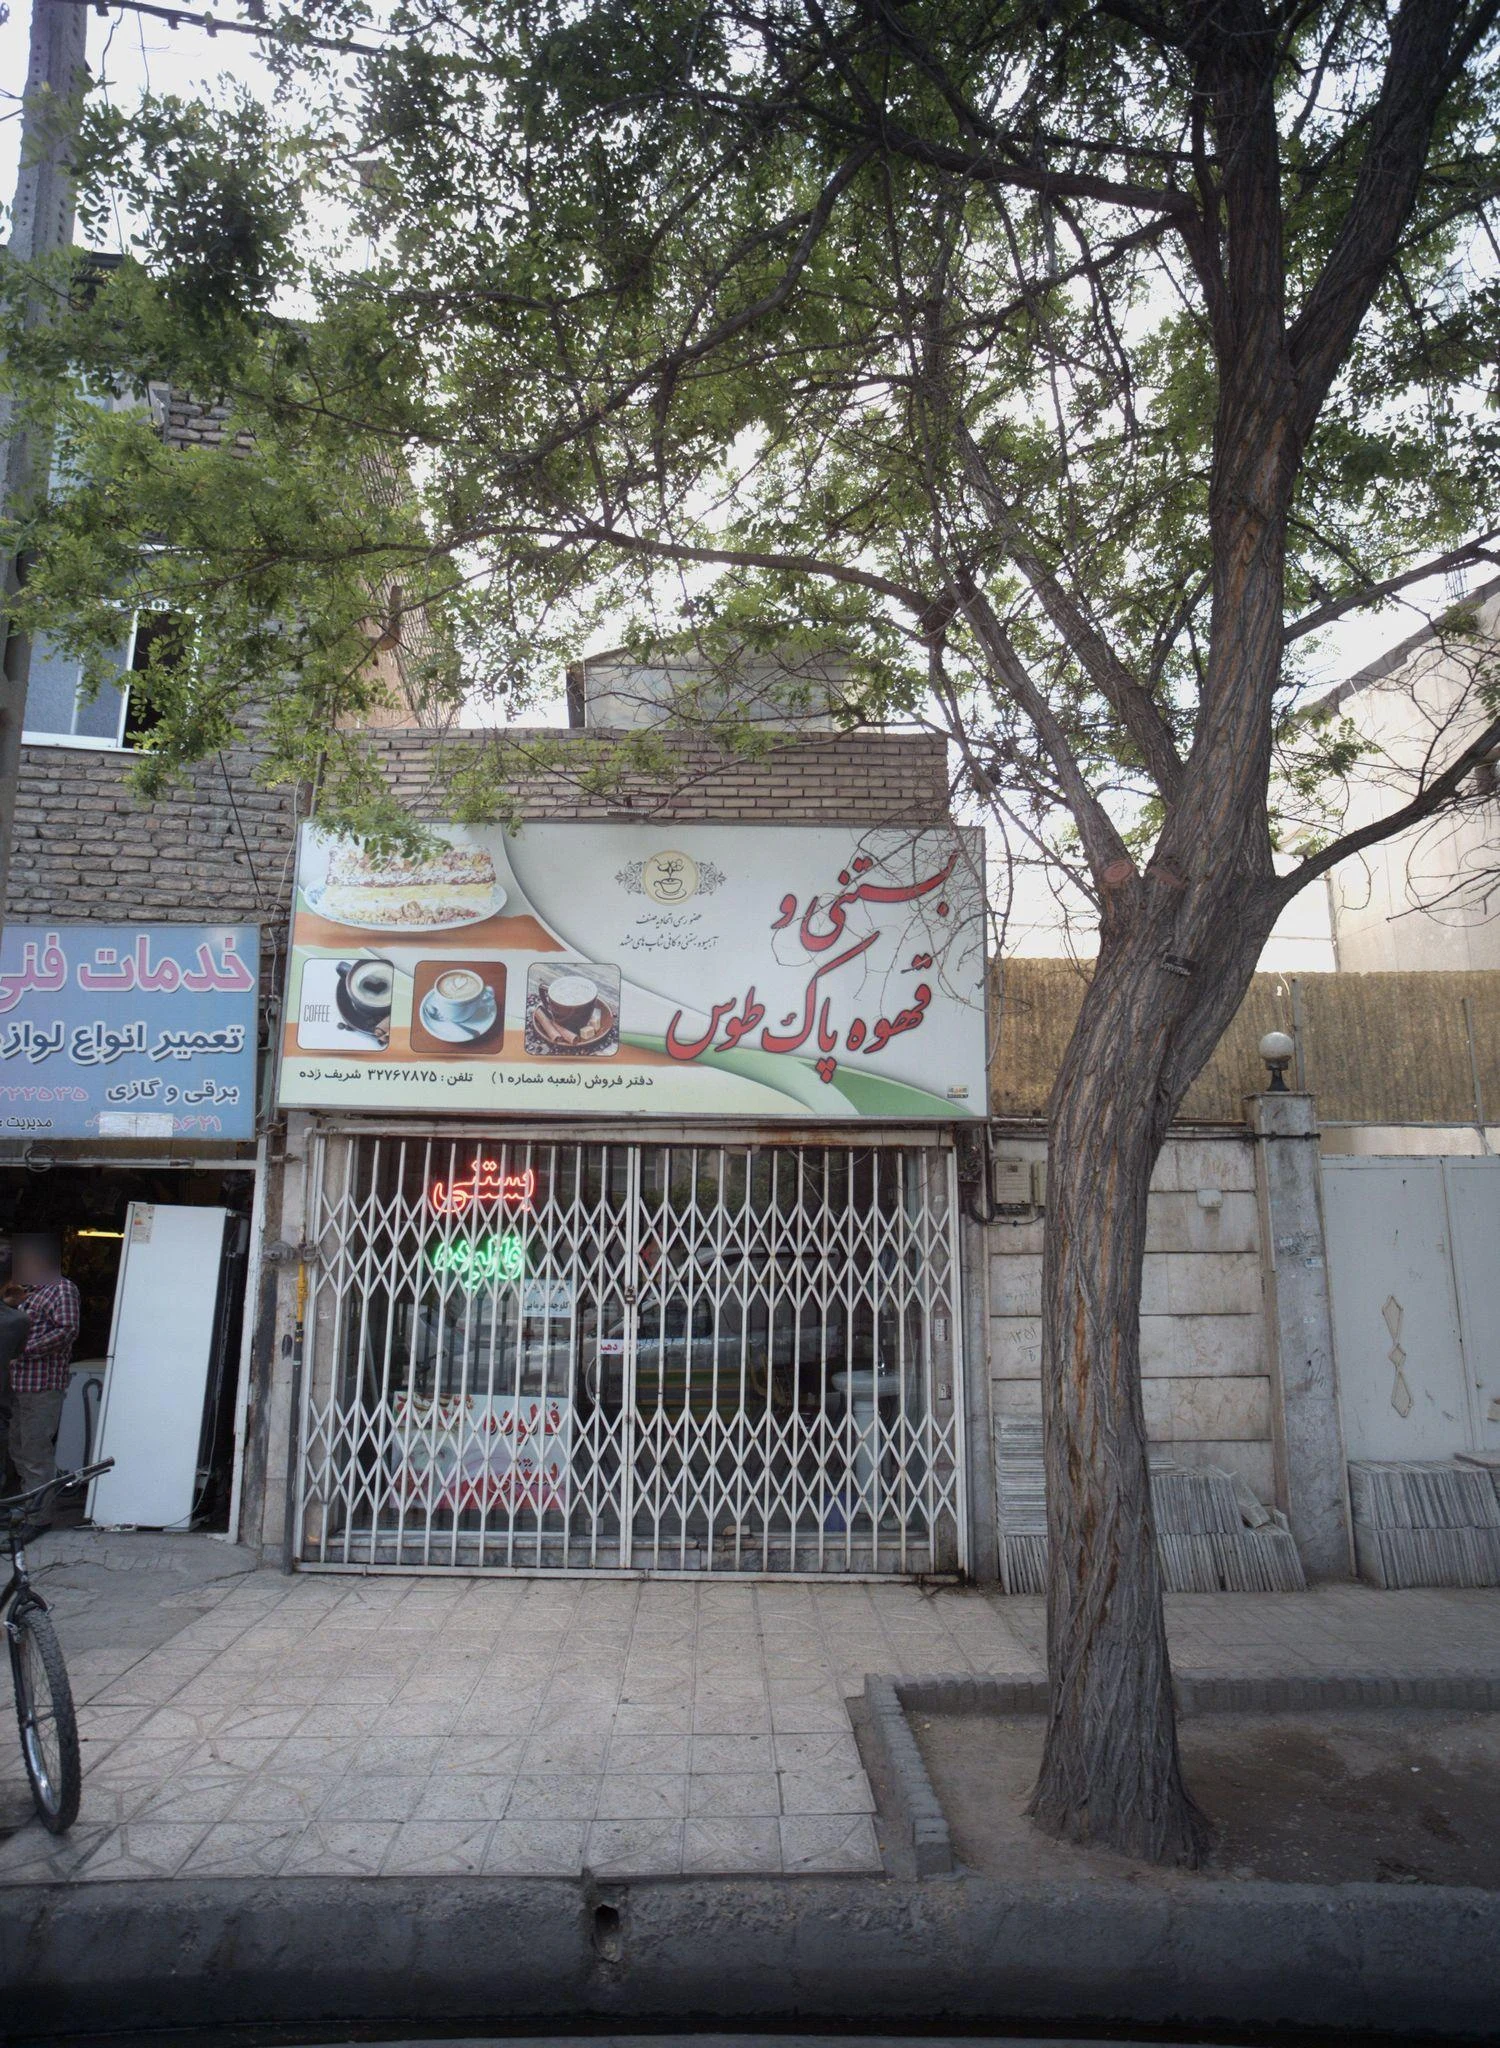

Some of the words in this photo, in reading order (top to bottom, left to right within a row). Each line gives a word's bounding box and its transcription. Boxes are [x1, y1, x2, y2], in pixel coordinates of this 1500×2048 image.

[771, 894, 797, 929] و
[800, 850, 960, 951] بستنی
[79, 935, 254, 992] خدمات
[303, 1004, 330, 1022] COFFEE
[846, 952, 932, 1054] قهوه
[666, 986, 765, 1061] طوس
[0, 1022, 64, 1063] لواز
[71, 1022, 147, 1065] انواع
[152, 1024, 245, 1061] تعمیر
[299, 1067, 321, 1080] زده
[325, 1067, 362, 1082] شریف
[367, 1068, 437, 1082] ۳۲۷۶۷۸۷۵
[507, 1072, 544, 1086] شماره
[547, 1072, 581, 1087] (شعبه
[584, 1074, 623, 1089] فروش
[625, 1074, 653, 1088] دفتر
[107, 1078, 161, 1102] گازی
[165, 1085, 179, 1104] و
[185, 1080, 239, 1104] برقی
[6, 1116, 53, 1130] مدیریت
[433, 1160, 534, 1212] بستنی
[483, 1401, 560, 1446] فلوده
